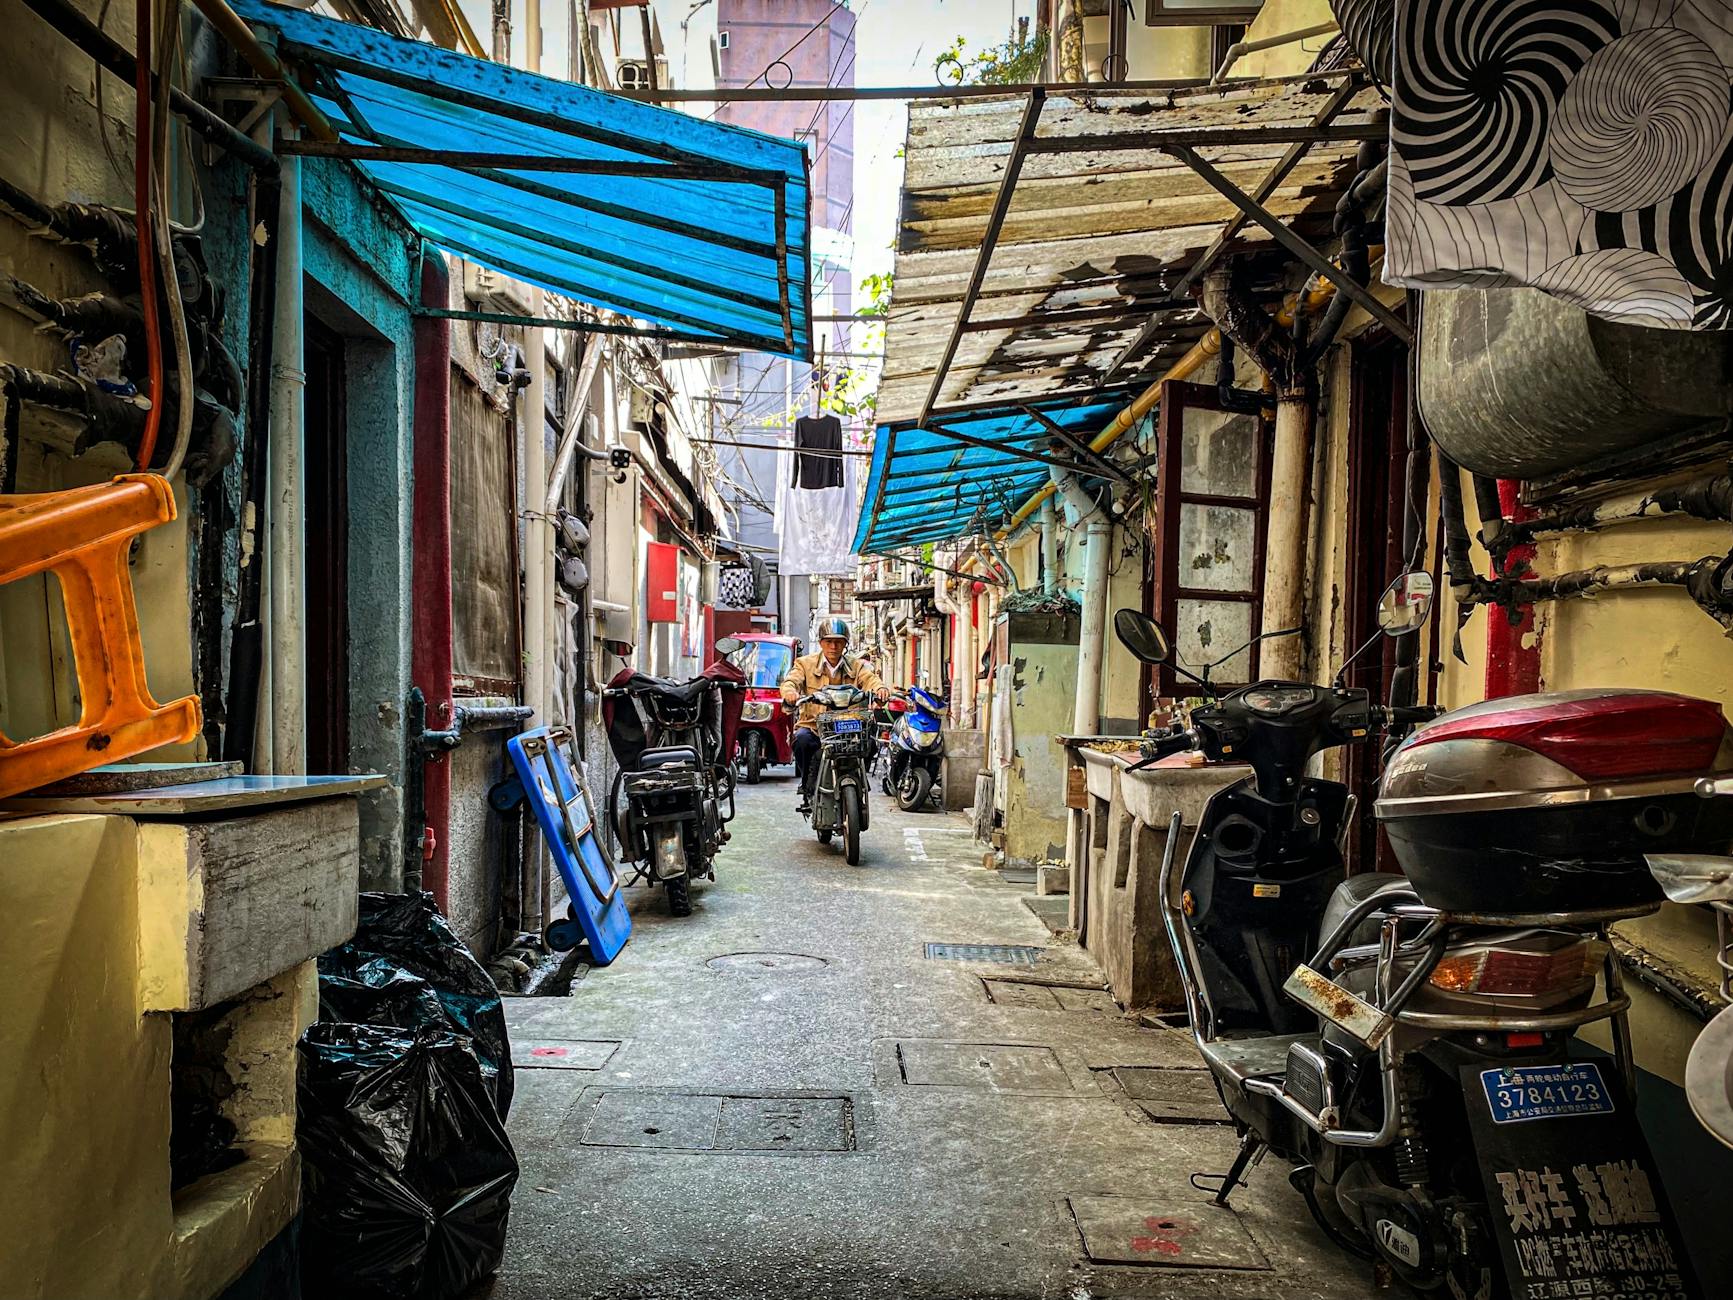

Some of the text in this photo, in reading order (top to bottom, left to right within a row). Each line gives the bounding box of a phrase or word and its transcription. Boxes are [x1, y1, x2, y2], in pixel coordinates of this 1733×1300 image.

[1498, 1083, 1600, 1109] 3784123
[1495, 1165, 1576, 1234] 买好车
